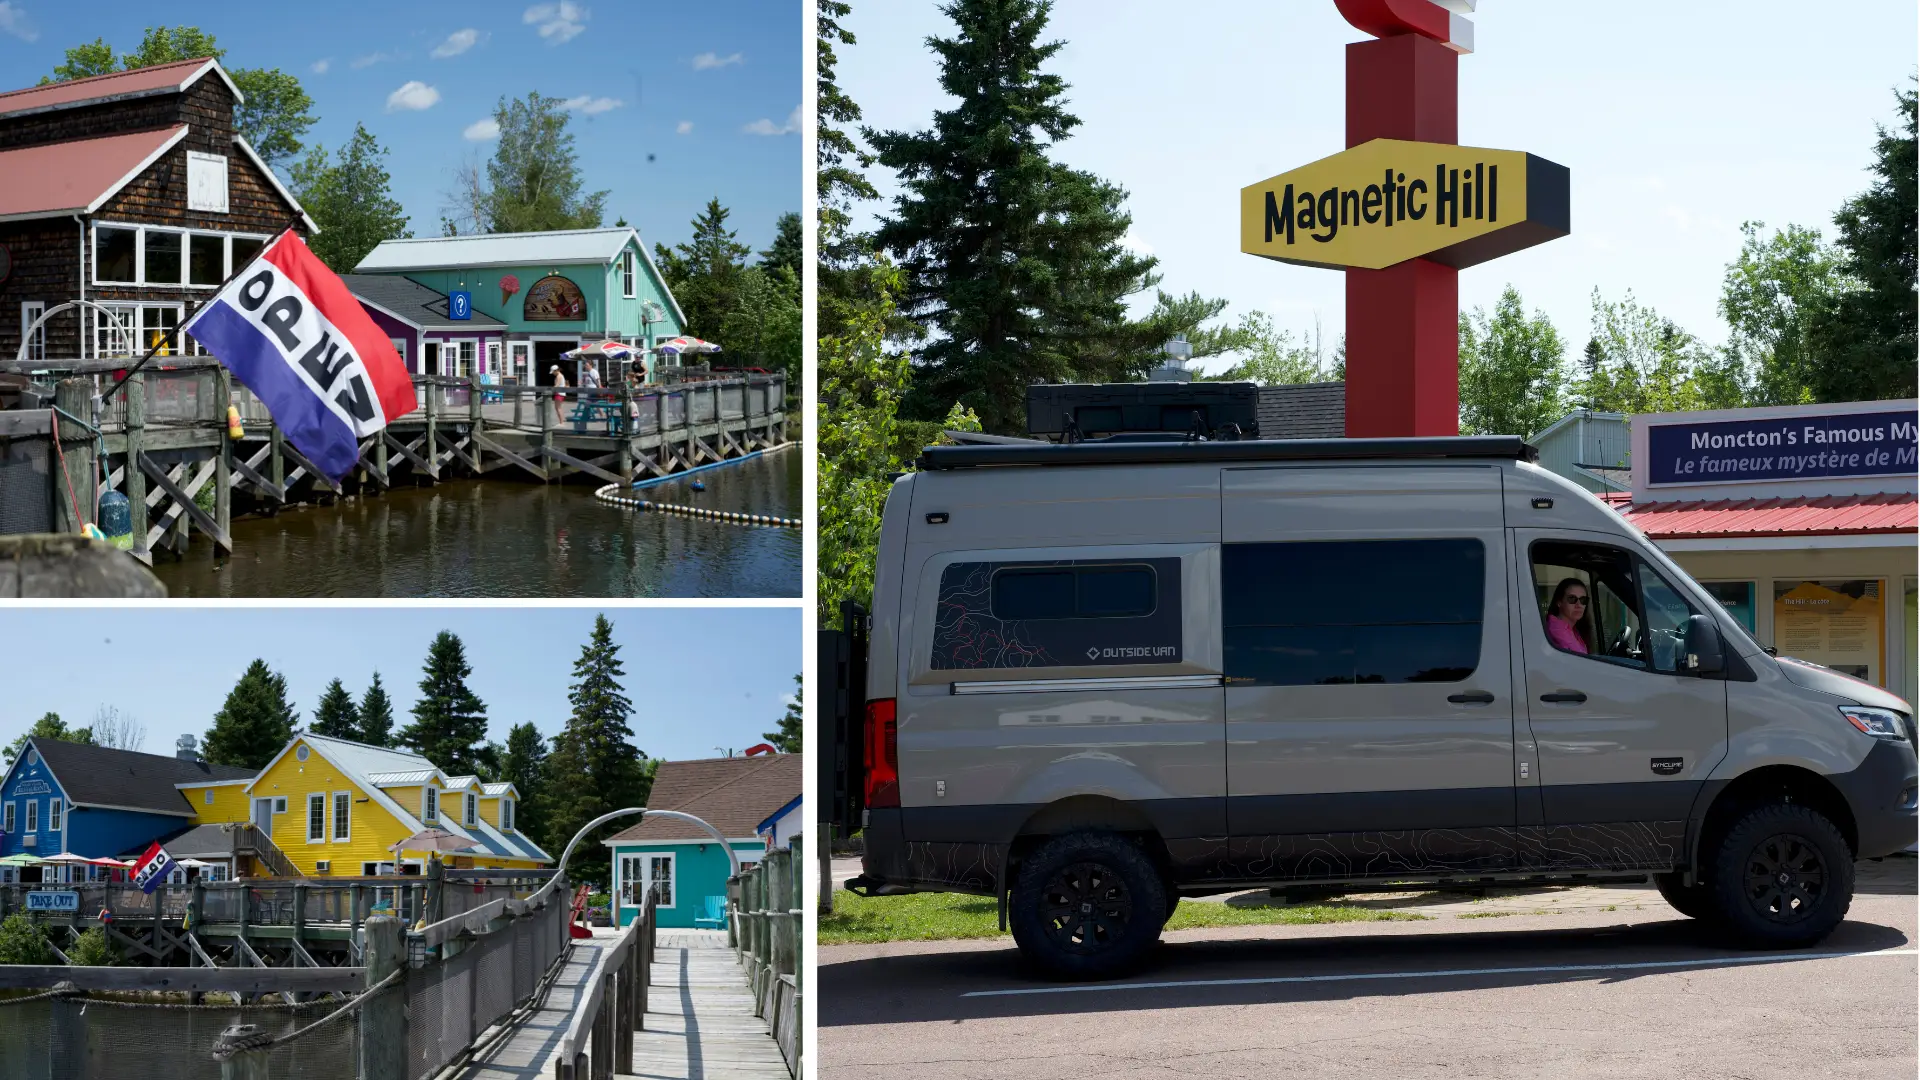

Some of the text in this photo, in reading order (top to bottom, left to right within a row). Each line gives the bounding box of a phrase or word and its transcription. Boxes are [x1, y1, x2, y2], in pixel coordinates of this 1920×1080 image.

[1264, 162, 1498, 245] Magnetic Hill
[238, 269, 376, 423] OPEN
[1691, 427, 1797, 450] Moncton's
[1804, 427, 1884, 444] Famous
[1674, 446, 1918, 474] Le fameux mystère de M
[1103, 646, 1176, 658] OUTSIDE VAN
[29, 894, 74, 908] TAKE OUT
